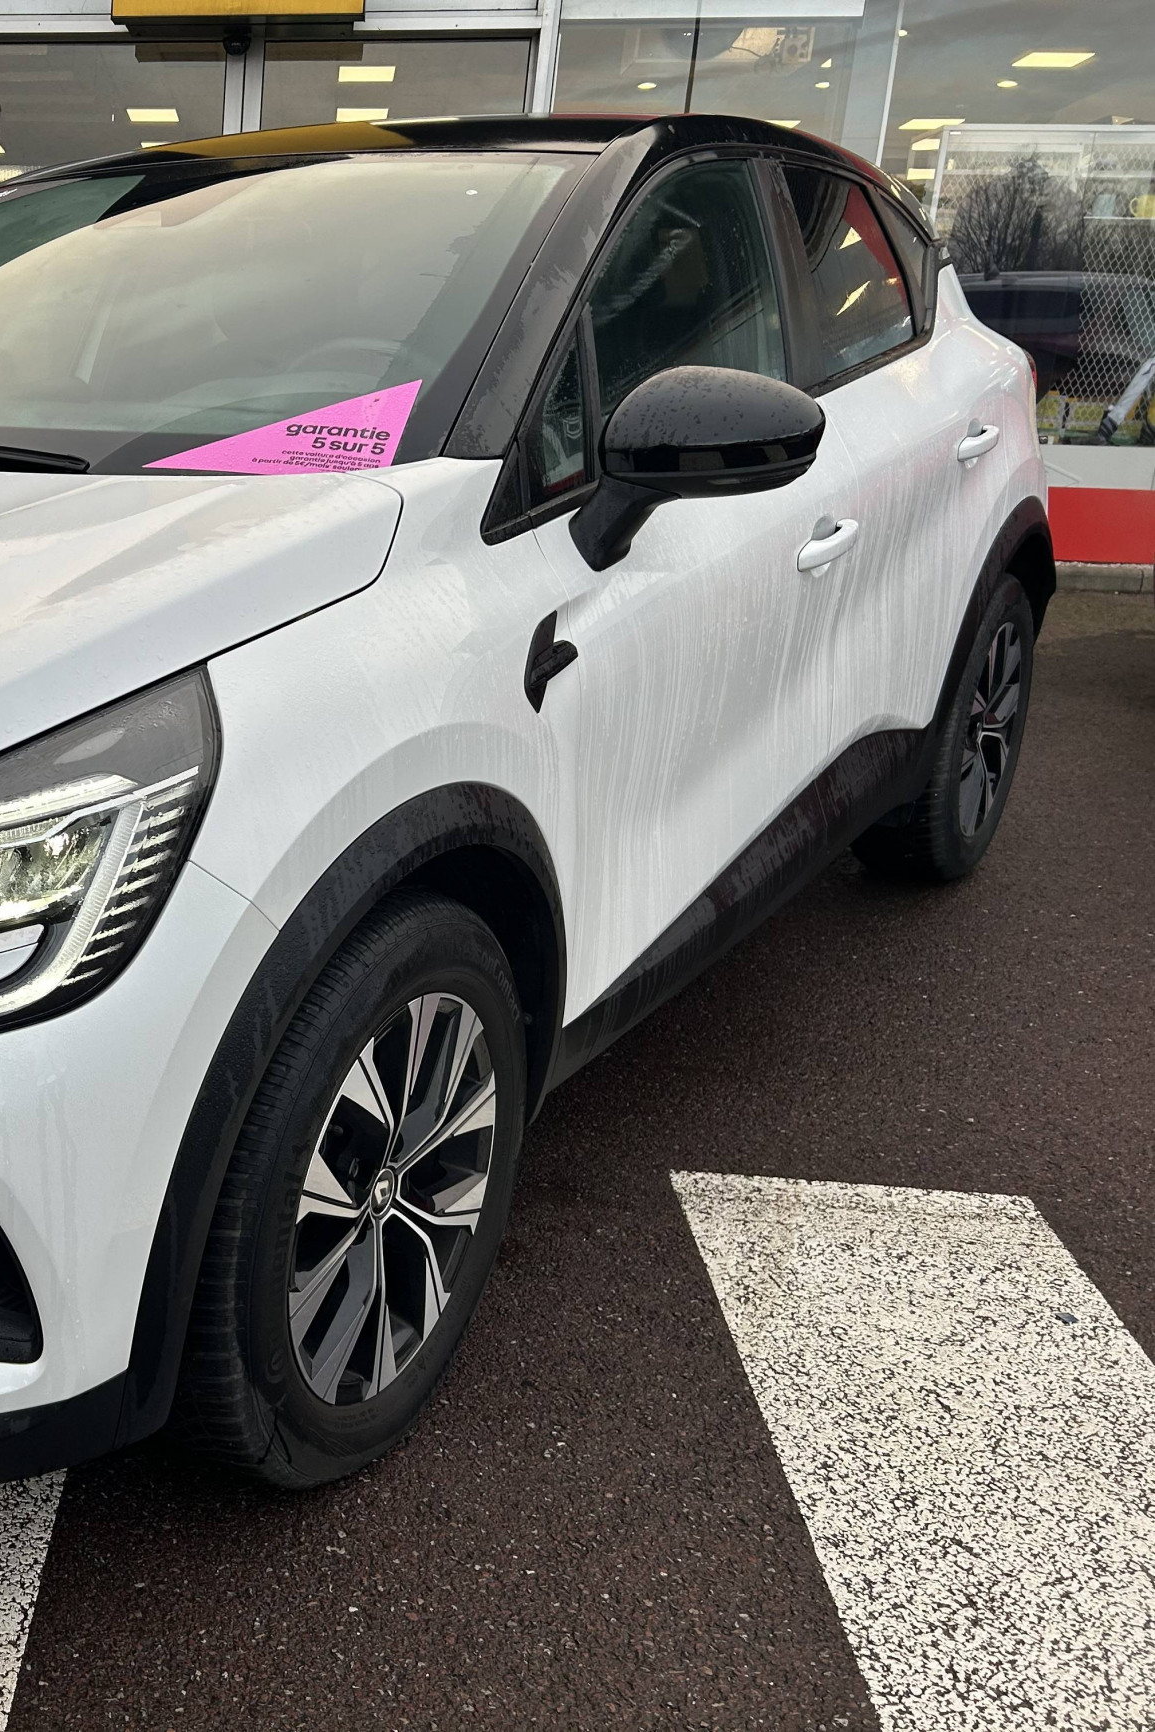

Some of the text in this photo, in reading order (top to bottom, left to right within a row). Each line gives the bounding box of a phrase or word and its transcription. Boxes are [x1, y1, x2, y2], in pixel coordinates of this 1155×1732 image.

[286, 424, 391, 441] garantie
[312, 437, 386, 455] 5 sur 5
[326, 458, 356, 466] jusqu'à
[335, 454, 381, 463] d'occasion
